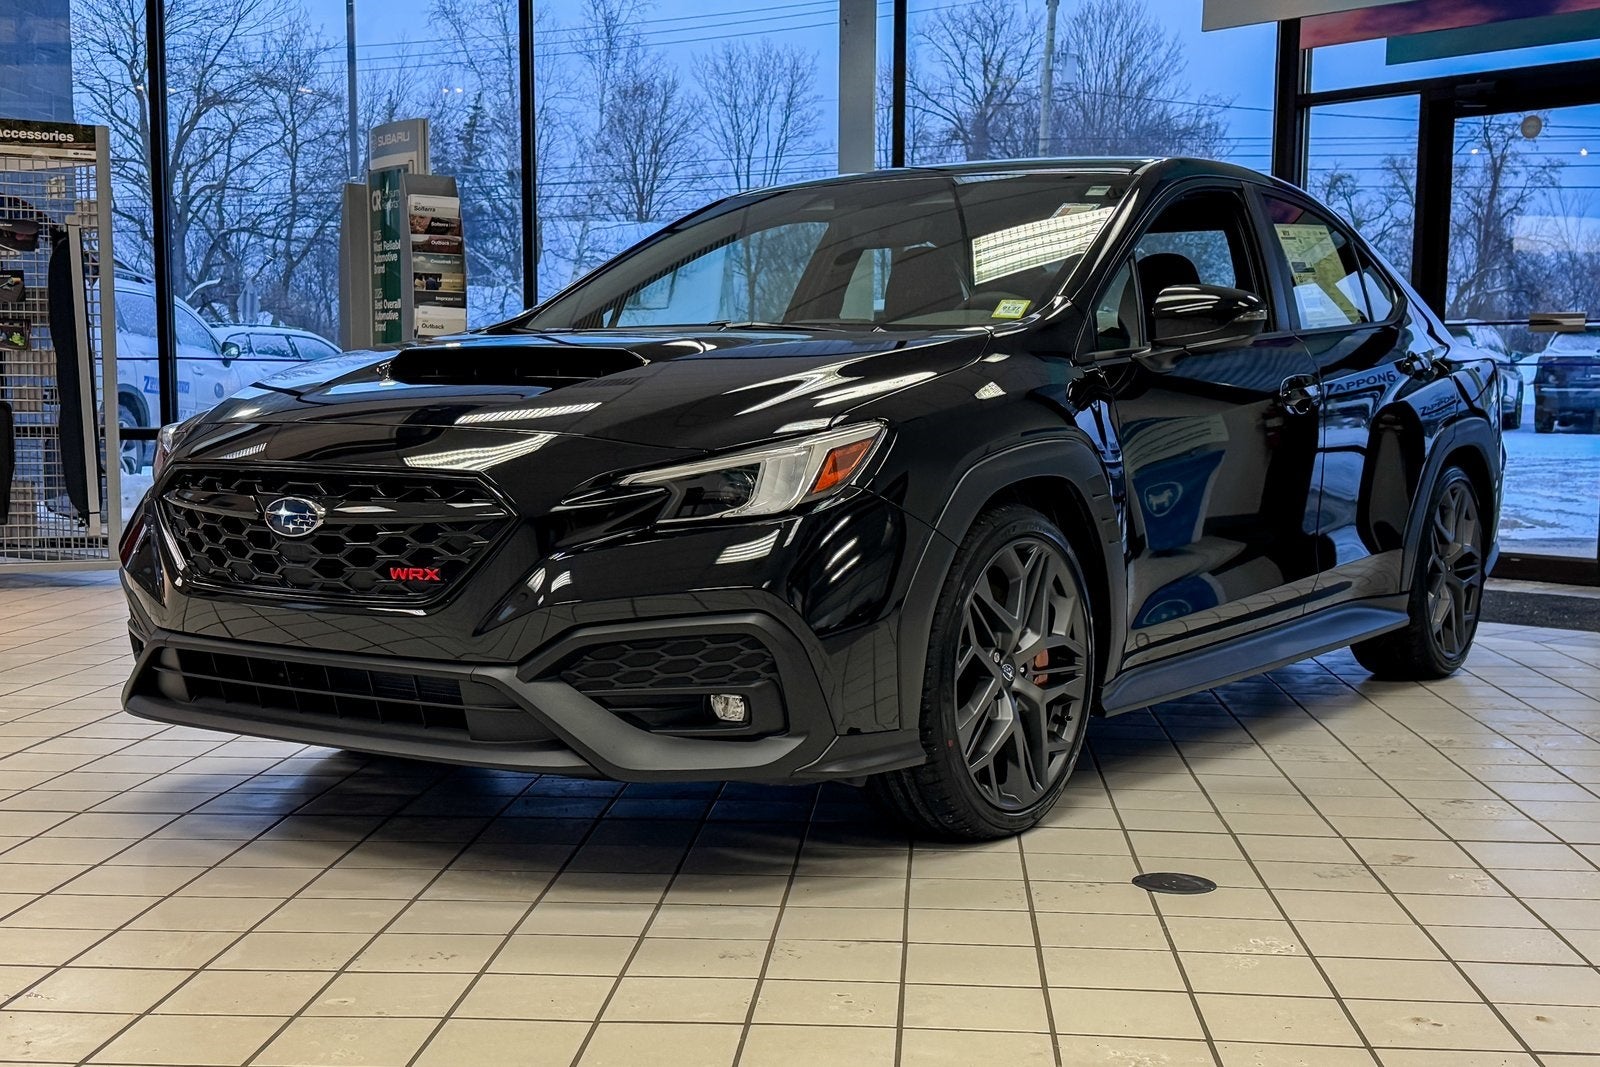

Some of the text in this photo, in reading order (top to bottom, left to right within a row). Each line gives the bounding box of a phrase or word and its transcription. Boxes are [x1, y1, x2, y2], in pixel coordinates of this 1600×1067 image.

[378, 131, 410, 147] SUBARU
[371, 189, 382, 211] CR
[383, 239, 401, 251] Reliabl
[421, 322, 444, 330] Outback
[389, 567, 441, 581] WRX
